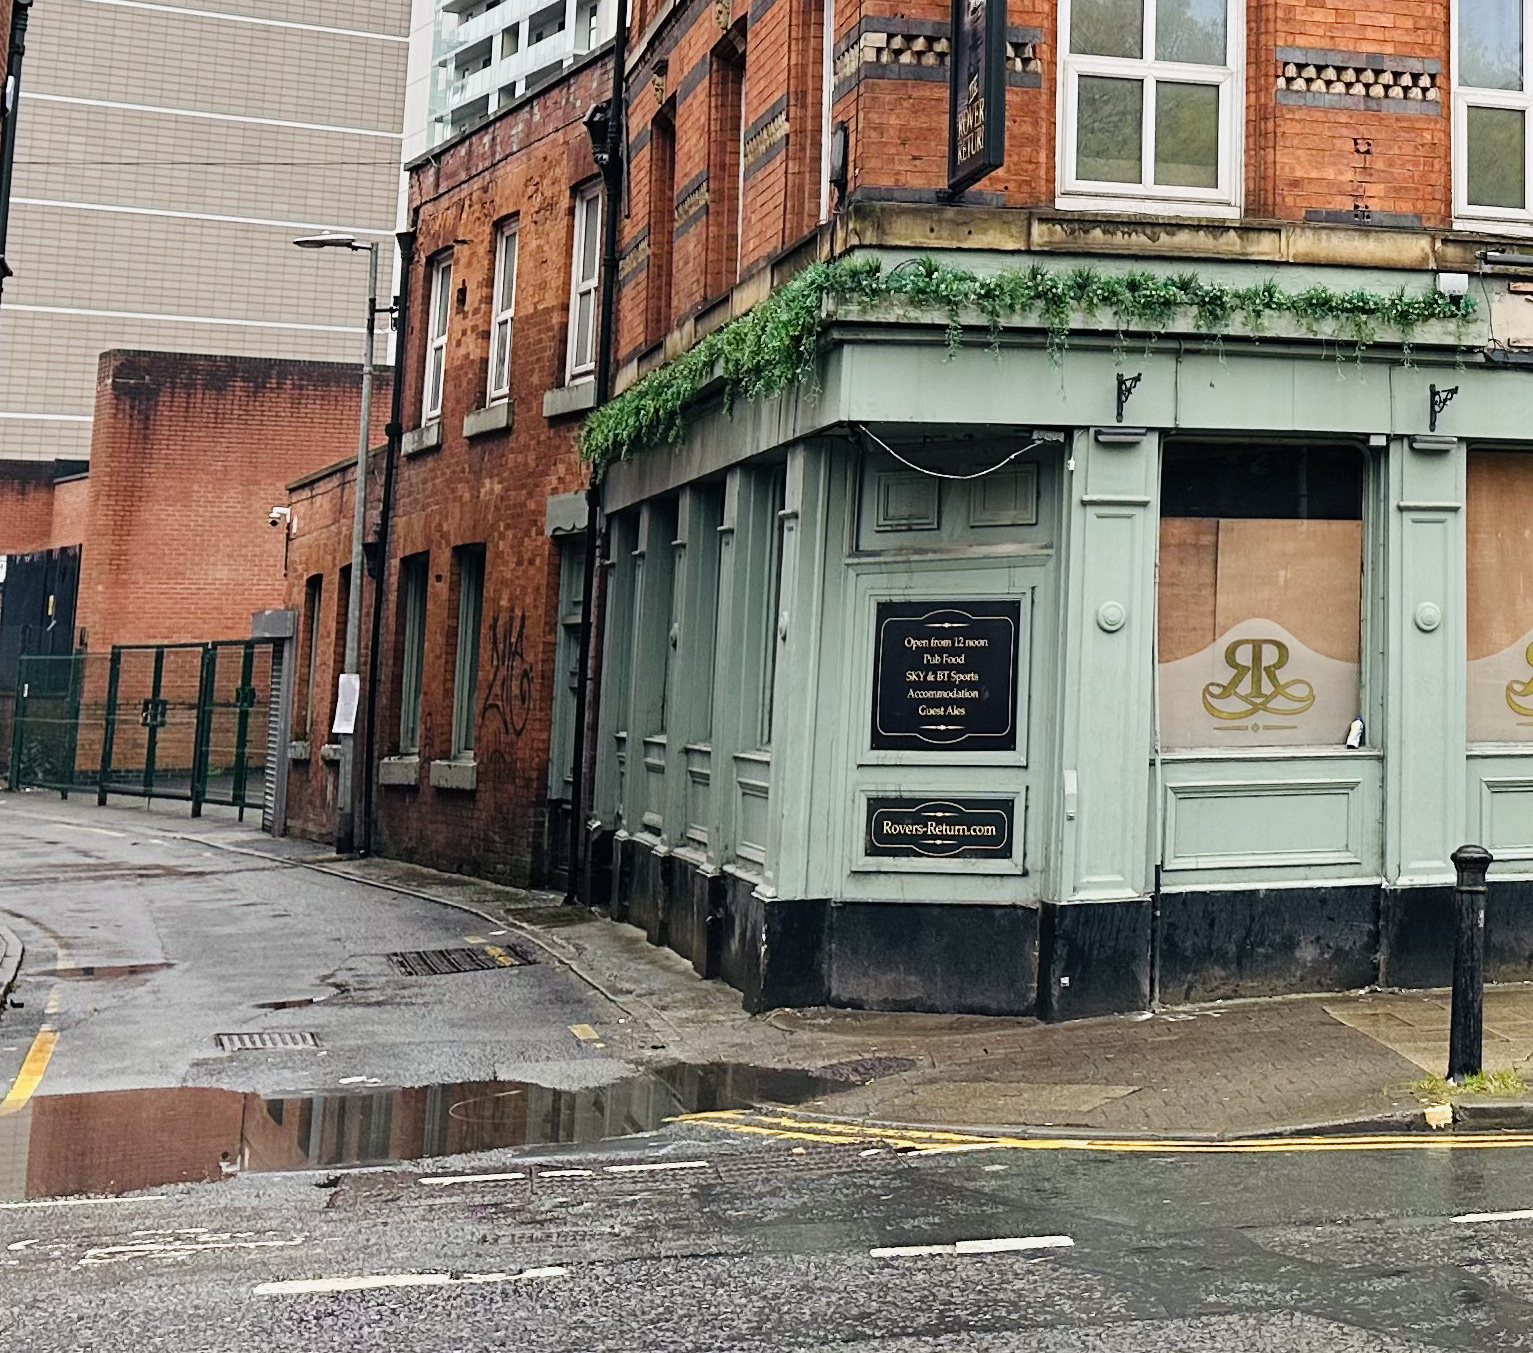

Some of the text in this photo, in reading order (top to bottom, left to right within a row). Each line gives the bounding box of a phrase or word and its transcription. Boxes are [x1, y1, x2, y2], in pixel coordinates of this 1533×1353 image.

[904, 636, 989, 651] Open from 12 noon
[923, 653, 965, 664] Pub Food
[905, 670, 979, 685] SKY & BT Sports
[906, 688, 979, 699] Accommodation
[918, 705, 966, 716] Guest Ales
[882, 820, 997, 836] Rovers-Return.com
